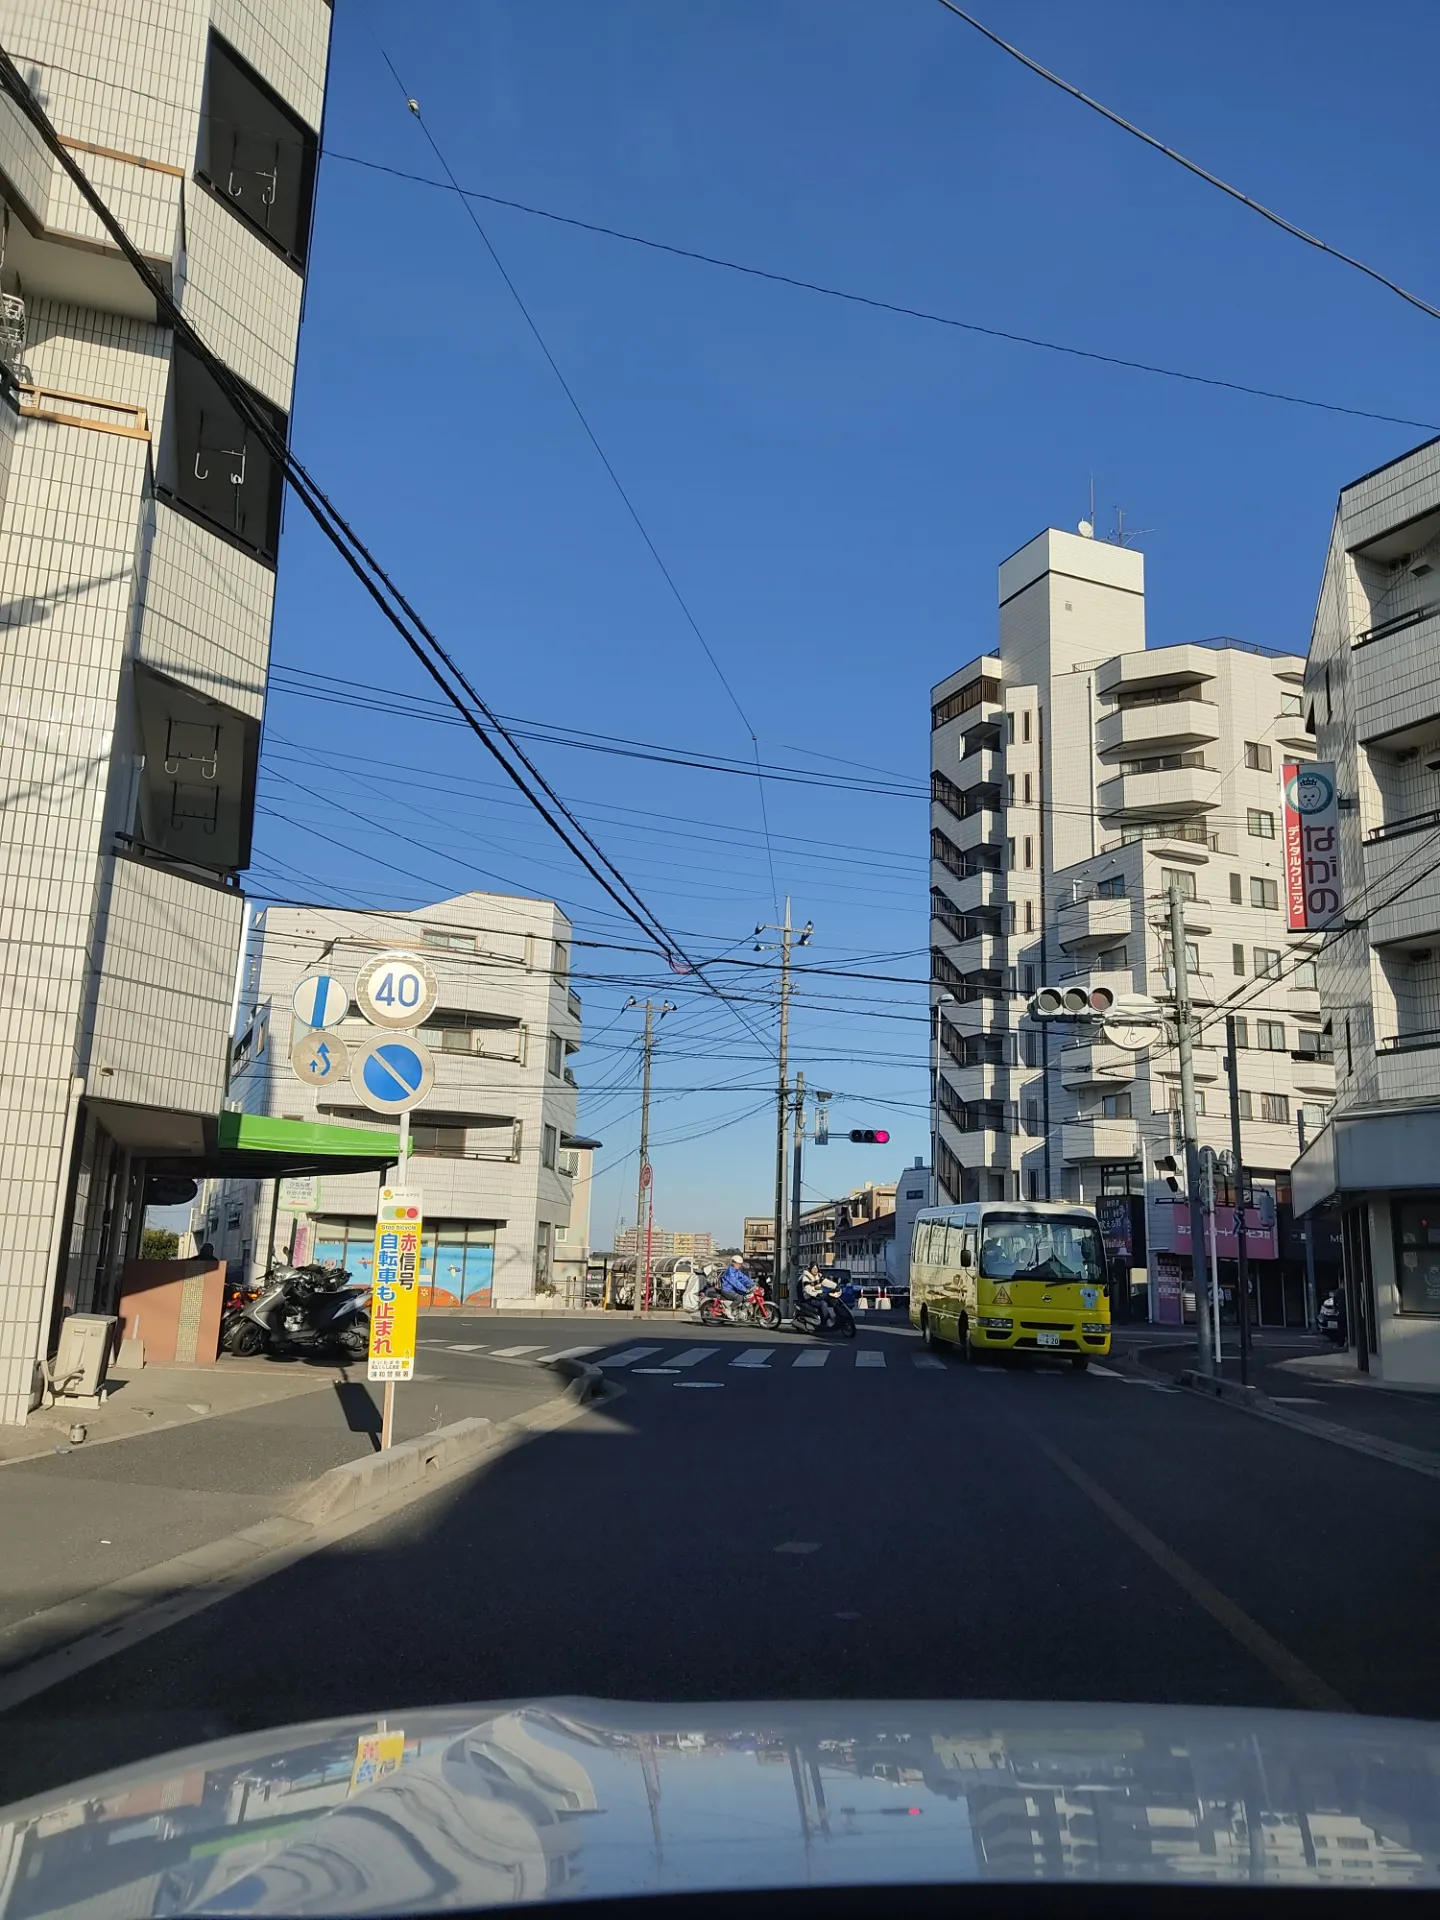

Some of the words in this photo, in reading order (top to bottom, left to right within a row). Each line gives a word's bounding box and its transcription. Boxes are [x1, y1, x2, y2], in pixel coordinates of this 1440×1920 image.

[1288, 825, 1304, 915] デンタルクリニック
[1304, 825, 1339, 914] ながの
[375, 973, 419, 1007] 40
[372, 1233, 398, 1354] 自転車も止まれ
[399, 1232, 417, 1291] 赤信号
